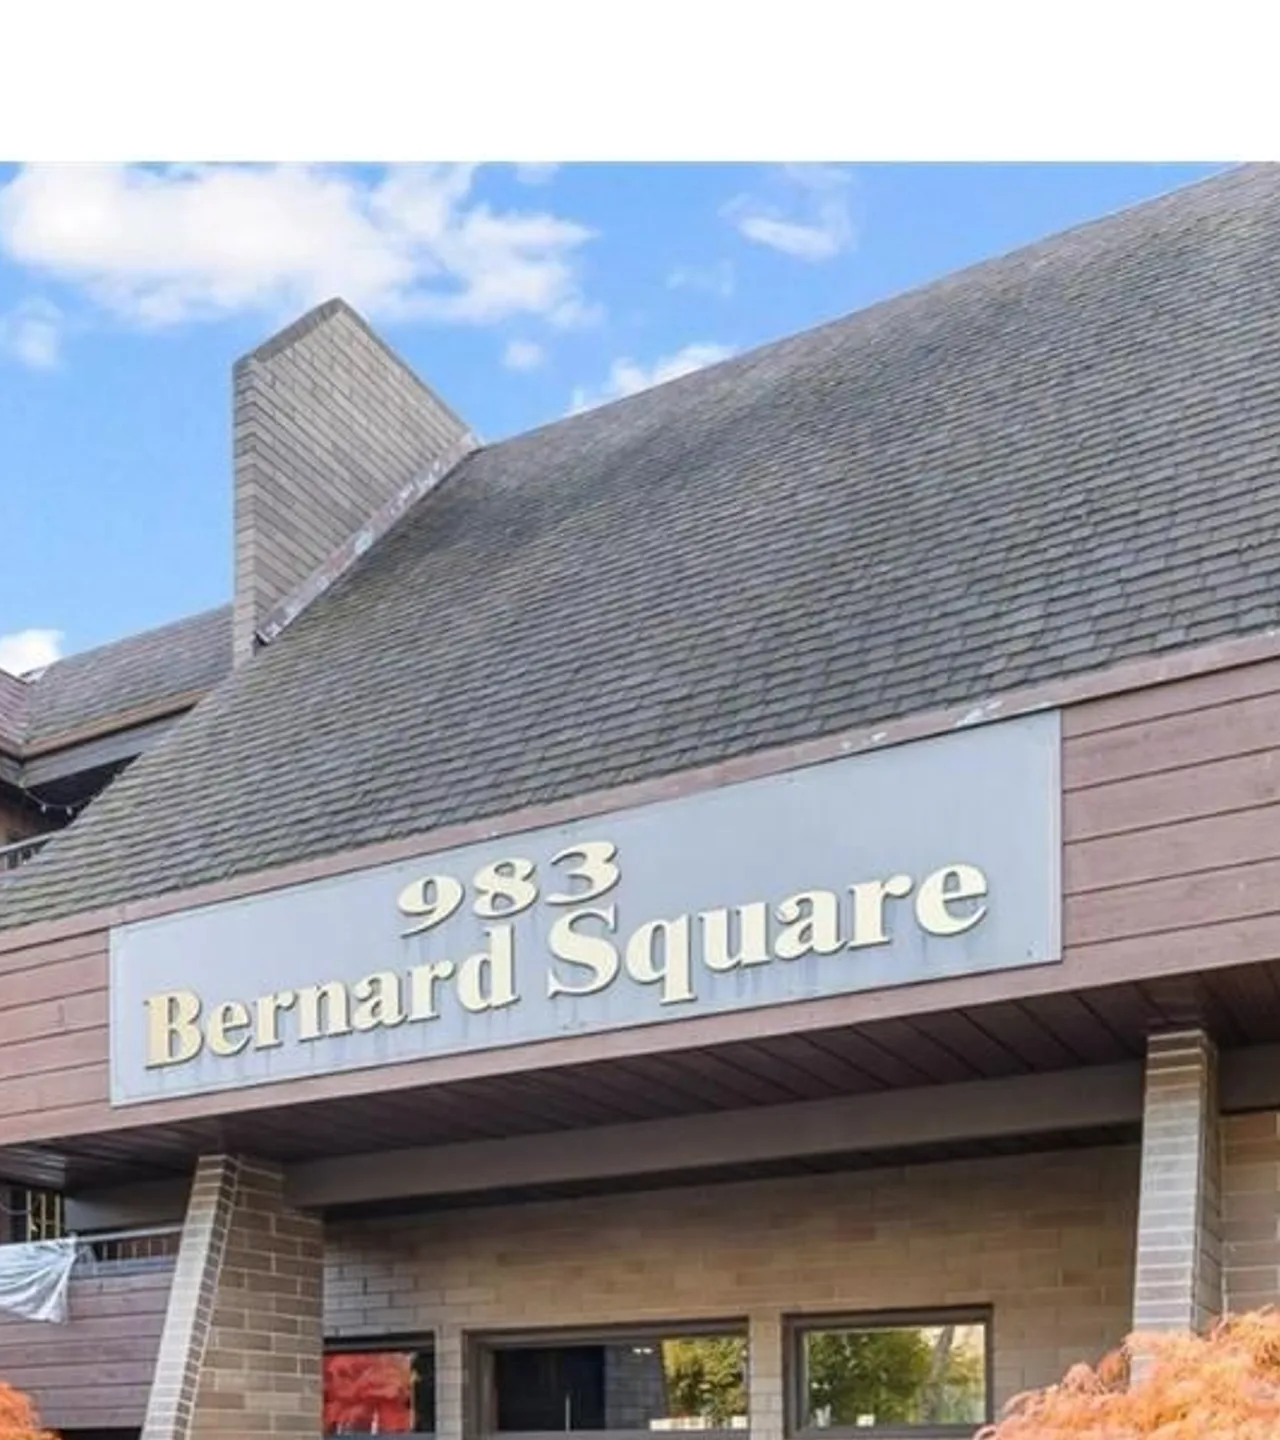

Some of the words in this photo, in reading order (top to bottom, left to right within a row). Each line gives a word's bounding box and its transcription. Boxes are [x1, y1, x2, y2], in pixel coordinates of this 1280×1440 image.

[397, 840, 622, 936] 983
[144, 926, 520, 1069] Bernard
[546, 862, 989, 1004] Square
